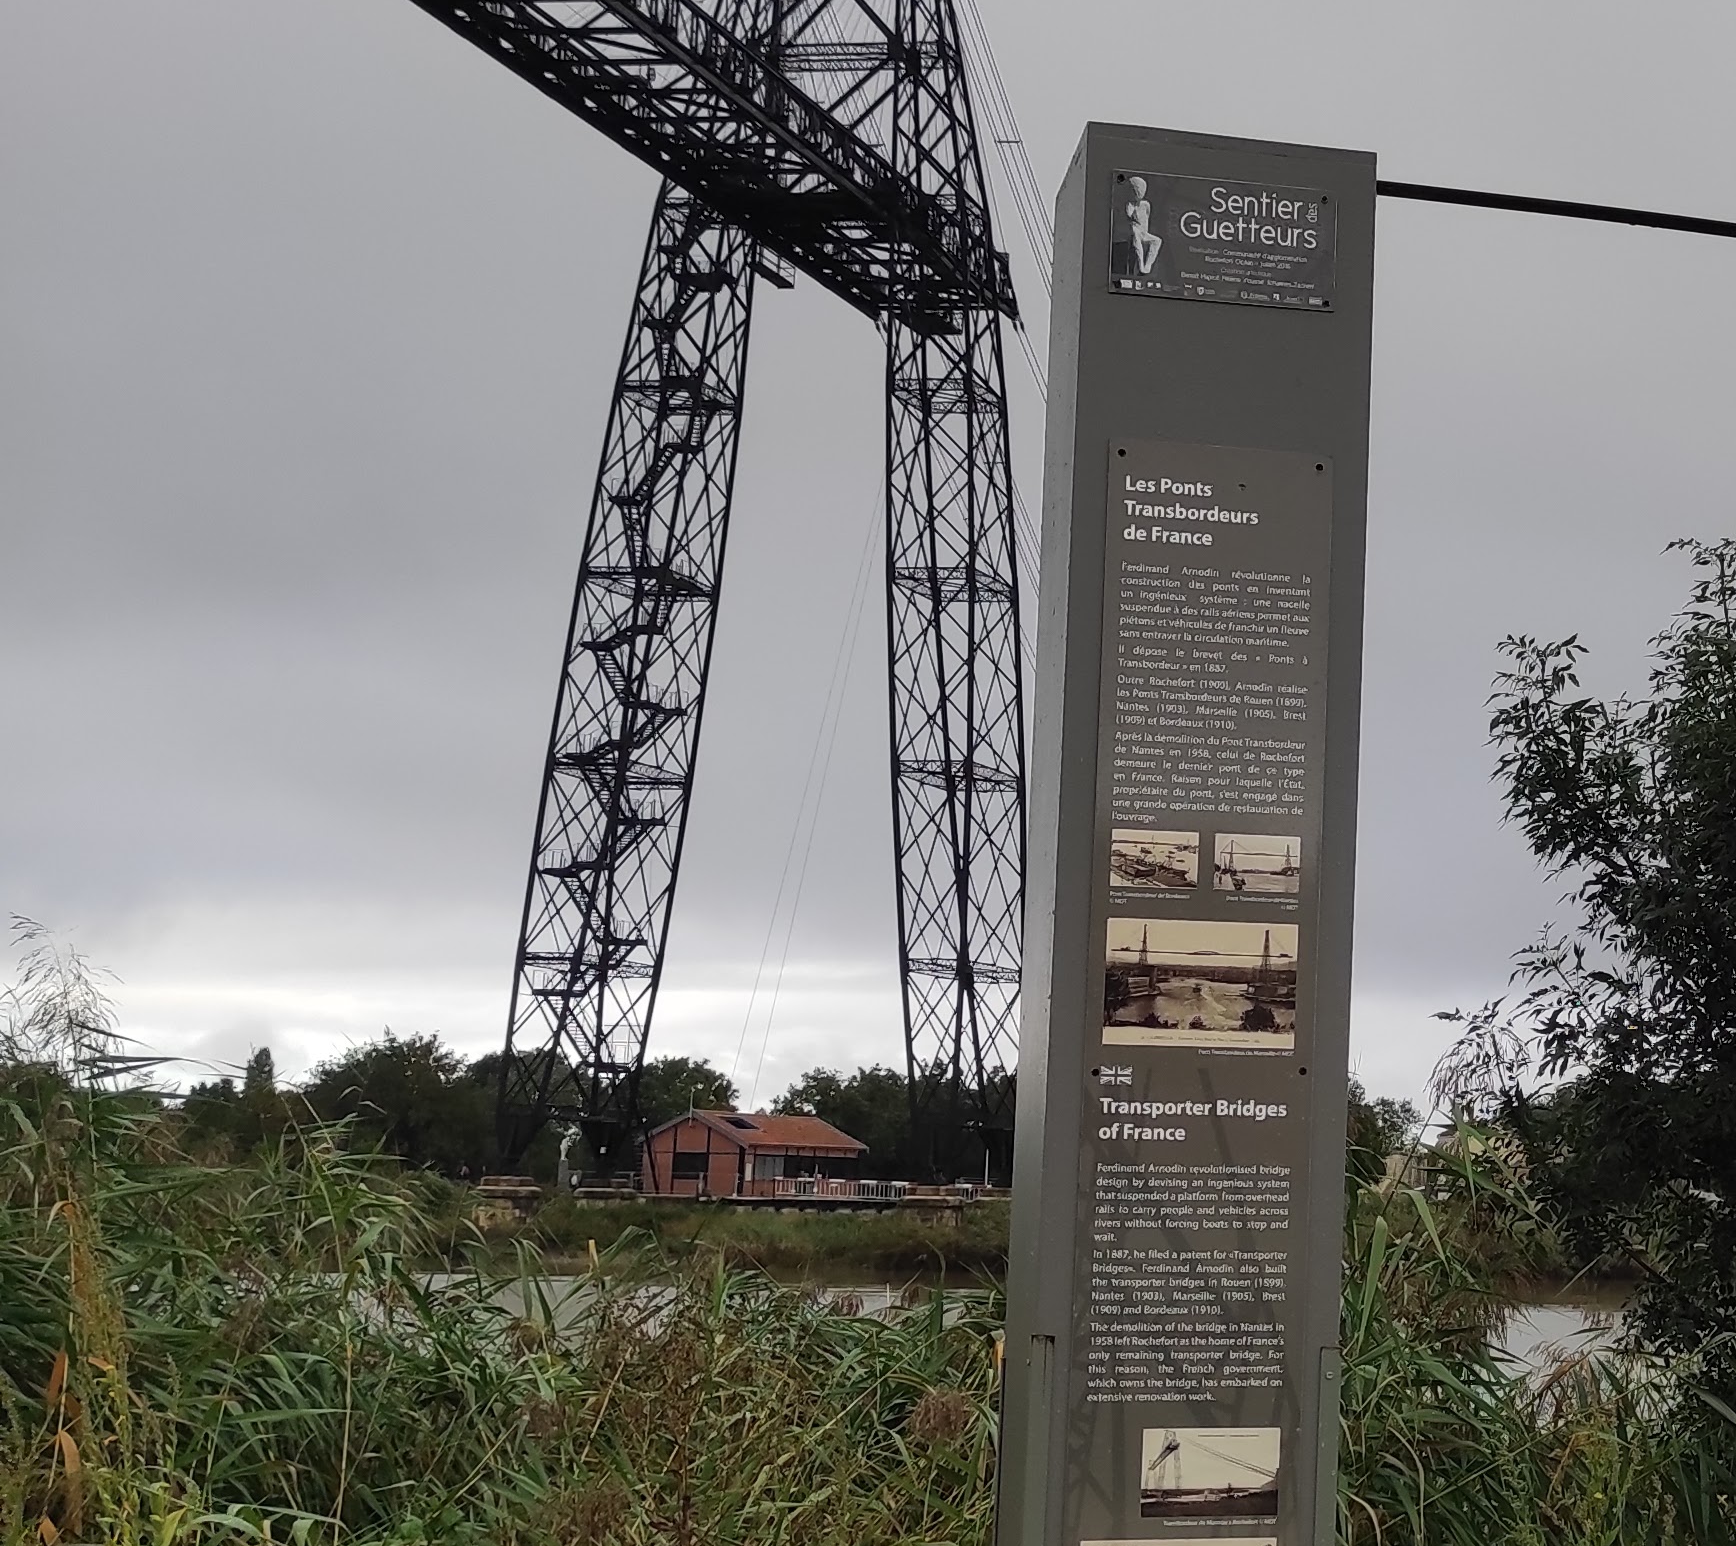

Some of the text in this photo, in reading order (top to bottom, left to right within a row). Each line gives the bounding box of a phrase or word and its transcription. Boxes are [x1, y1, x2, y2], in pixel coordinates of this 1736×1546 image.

[1210, 187, 1303, 222] Sentier
[1305, 202, 1318, 223] des
[1180, 212, 1317, 249] Guetteurs
[1125, 474, 1214, 497] Les Ponts
[1123, 500, 1260, 525] Transbordeurs
[1123, 524, 1214, 546] de France
[1122, 562, 1169, 573] Ferdinand
[1181, 567, 1219, 576] Arnodin
[1302, 574, 1310, 584] la
[1121, 578, 1180, 587] construction
[1188, 580, 1204, 589] des
[1212, 583, 1239, 592] ponts
[1116, 701, 1149, 711] Nantes
[1196, 706, 1237, 716] Marseille
[1283, 710, 1306, 720] Brest
[1114, 744, 1126, 753] de
[1132, 746, 1164, 755] Nantes
[1216, 749, 1238, 759] celui
[1243, 751, 1255, 760] de
[1260, 752, 1304, 762] Rochefort
[1114, 758, 1156, 768] demeure
[1162, 760, 1171, 769] le
[1178, 761, 1213, 770] dernier
[1247, 764, 1260, 773] de
[1284, 768, 1305, 777] type
[1113, 786, 1168, 796] propriétaire
[1173, 788, 1185, 796] du
[1281, 793, 1304, 802] dans
[1099, 1097, 1288, 1122] Transporter Bridges
[1098, 1122, 1186, 1142] of France
[1097, 1163, 1290, 1176] Ferdinand Arnodin revolutionised bridge
[1096, 1176, 1128, 1188] design
[1132, 1177, 1145, 1188] by
[1148, 1177, 1187, 1189] devising
[1207, 1179, 1253, 1190] ingenious
[1257, 1180, 1289, 1190] system
[1095, 1204, 1114, 1213] rails
[1118, 1204, 1129, 1213] to
[1132, 1206, 1156, 1216] carry
[1160, 1205, 1193, 1216] people
[1196, 1205, 1214, 1214] and
[1219, 1206, 1256, 1215] vehicles
[1094, 1218, 1120, 1227] rivers
[1124, 1219, 1161, 1227] without
[1165, 1219, 1198, 1230] forcing
[1202, 1219, 1228, 1228] boats
[1246, 1221, 1267, 1231] stop
[1270, 1219, 1289, 1228] and
[1091, 1291, 1124, 1300] Nantes
[1173, 1291, 1216, 1300] Marseille
[1262, 1292, 1285, 1301] Brest
[1090, 1322, 1284, 1334] The demolition of the bridge in Nantes in
[1088, 1351, 1110, 1361] only
[1116, 1351, 1164, 1361] remaining
[1170, 1350, 1224, 1361] transporter
[1268, 1350, 1284, 1359] For
[1088, 1364, 1106, 1373] this
[1158, 1364, 1174, 1373] the
[1182, 1363, 1214, 1373] French
[1087, 1378, 1116, 1387] which
[1147, 1378, 1163, 1387] the
[1202, 1377, 1218, 1387] has
[1220, 1377, 1268, 1386] embarked
